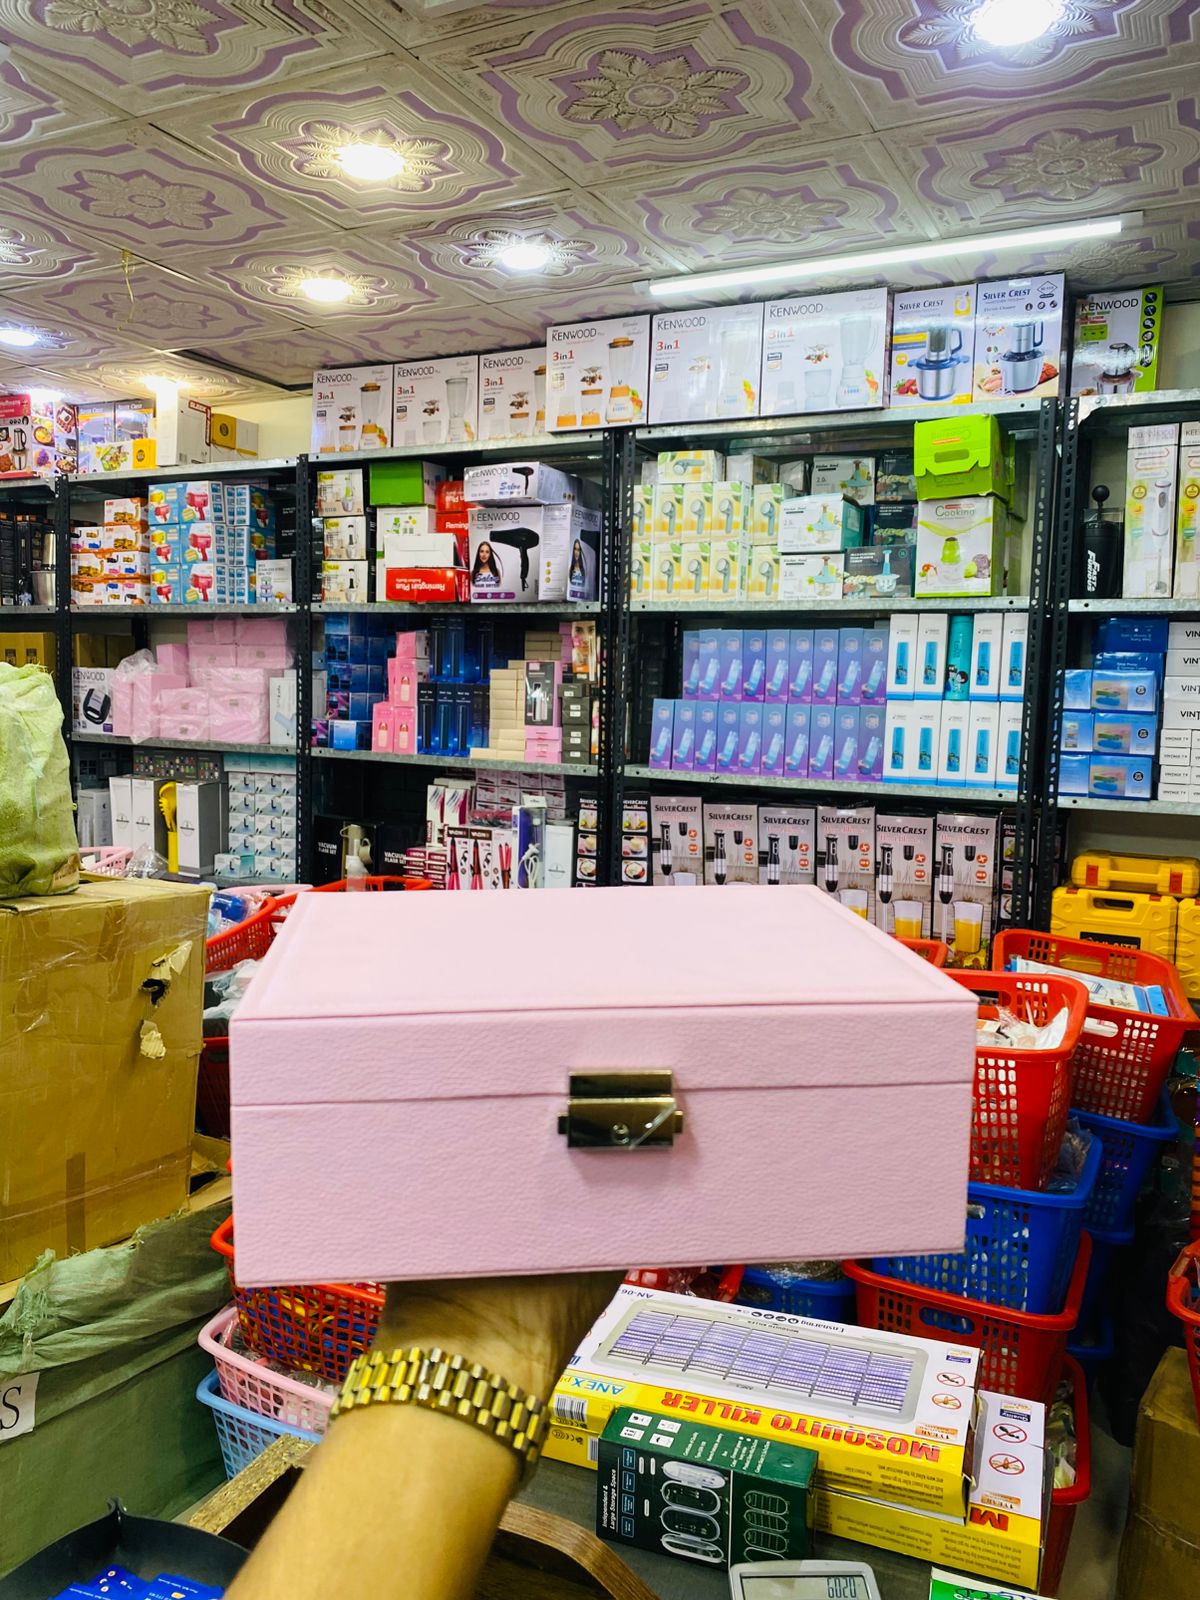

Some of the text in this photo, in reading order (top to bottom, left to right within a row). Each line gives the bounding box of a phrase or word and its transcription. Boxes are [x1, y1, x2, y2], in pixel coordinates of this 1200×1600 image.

[983, 291, 1006, 300] SILVER
[1008, 288, 1031, 298] CREST
[769, 303, 824, 318] KENWOOD
[899, 300, 944, 310] SILVER CREST
[1081, 298, 1138, 312] KENWOOD
[656, 316, 706, 331] KENWOOD
[552, 328, 597, 342] KENWOOD
[482, 356, 524, 369] KENWOOD
[397, 366, 434, 378] KENWOOD
[317, 373, 352, 384] KENWOOD
[936, 506, 975, 518] Cooking
[396, 580, 446, 592] Remington Plus
[73, 672, 105, 680] KENWOOD
[318, 842, 338, 850] VACUUM
[620, 1288, 654, 1298] AN-06
[573, 1377, 624, 1396] ANEX
[660, 1392, 762, 1426] KILLER
[770, 1414, 940, 1463] MOSQUITO
[608, 1468, 616, 1487] Space
